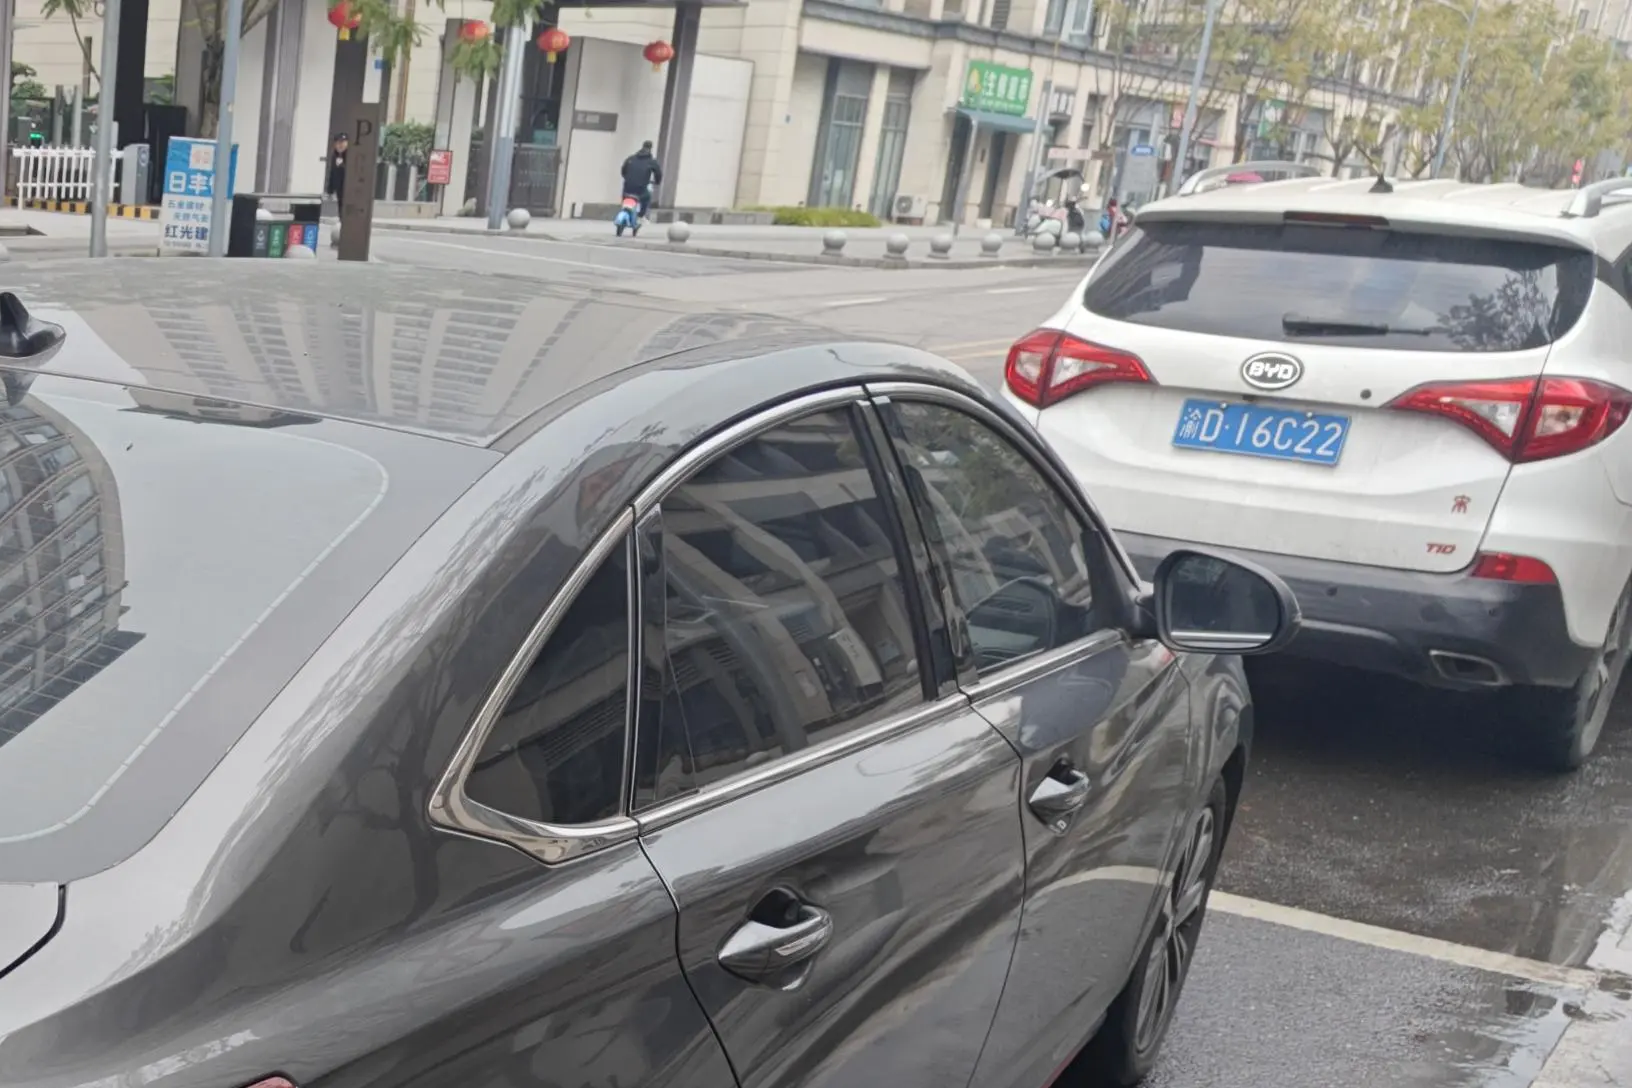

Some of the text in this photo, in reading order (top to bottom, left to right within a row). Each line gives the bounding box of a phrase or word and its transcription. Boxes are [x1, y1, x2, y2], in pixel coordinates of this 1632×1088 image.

[354, 118, 373, 146] P
[169, 171, 215, 195] 日丰
[164, 224, 209, 241] 红光建
[1249, 361, 1294, 380] BYD
